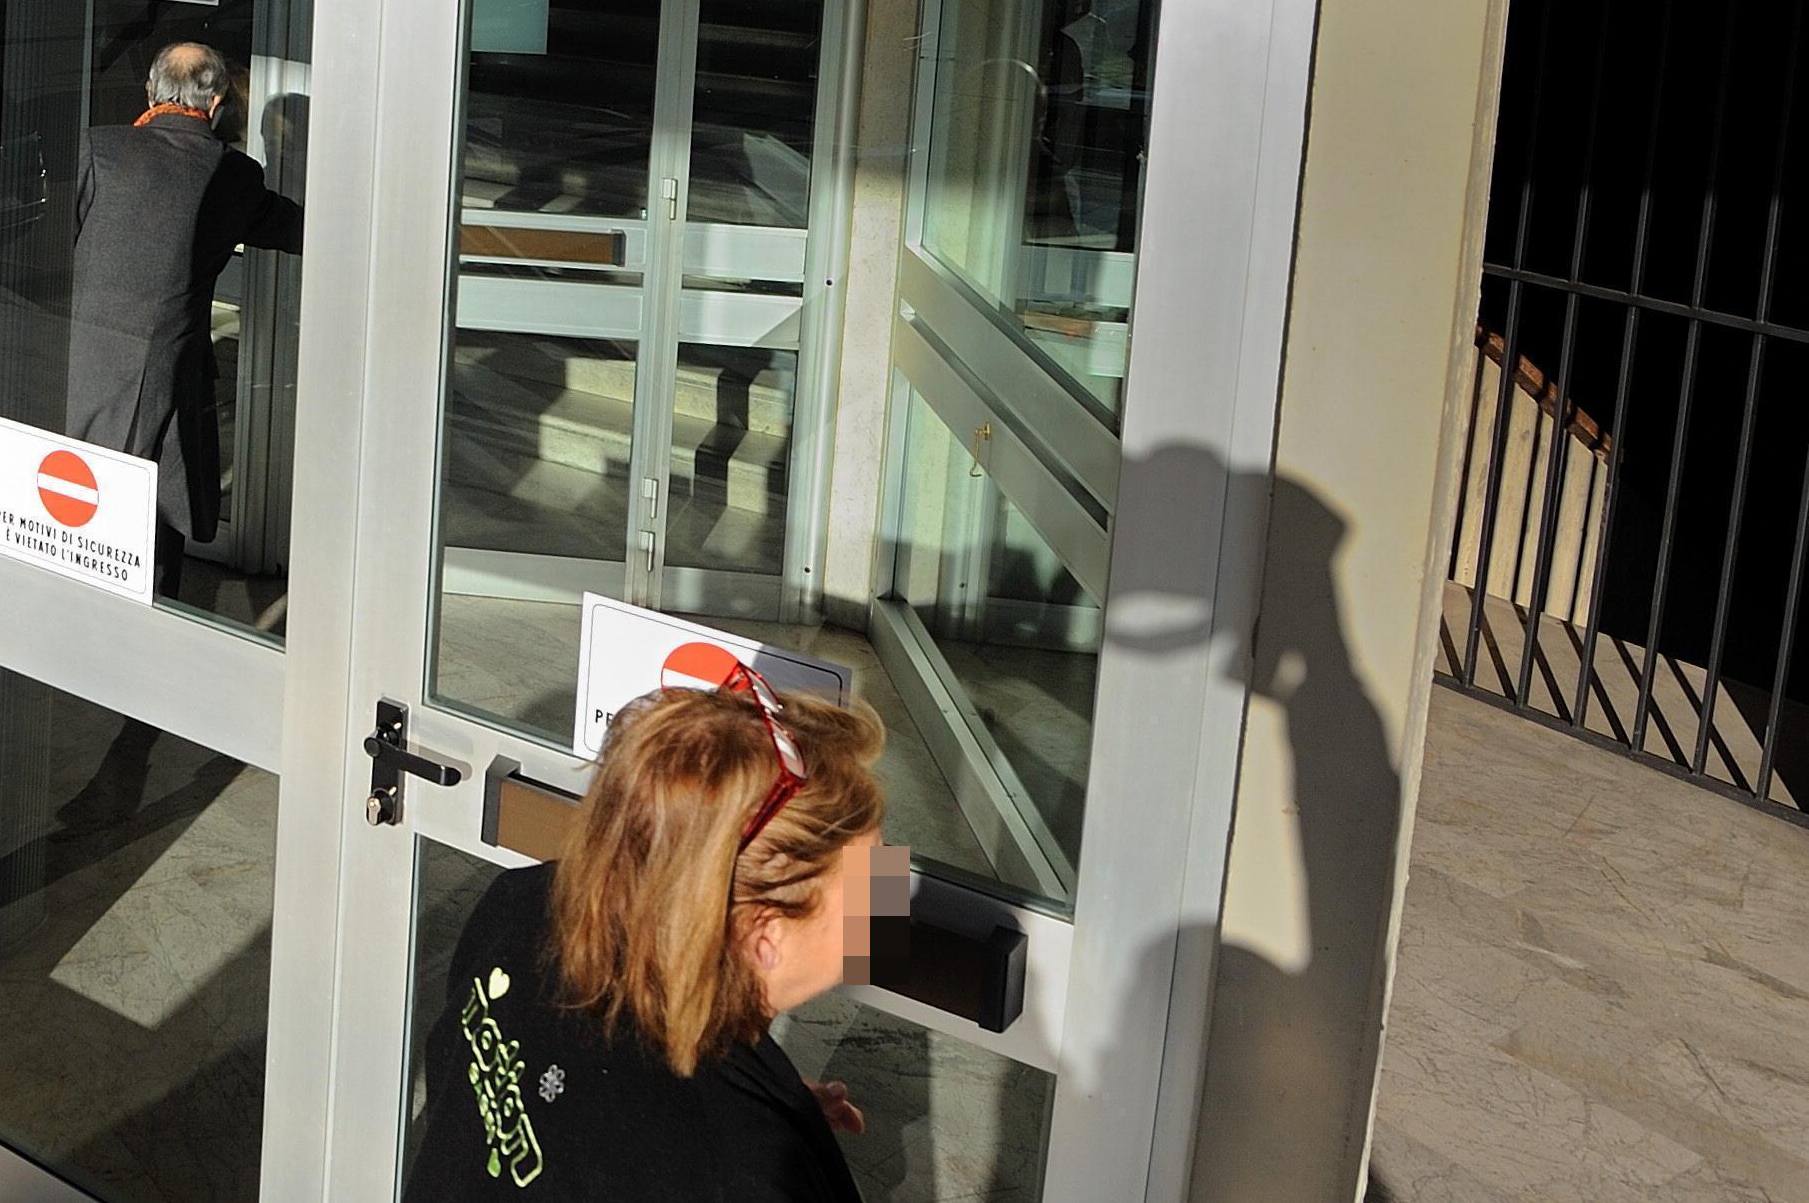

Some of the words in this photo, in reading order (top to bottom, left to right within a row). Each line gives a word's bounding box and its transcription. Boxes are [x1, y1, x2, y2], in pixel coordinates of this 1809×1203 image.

[6, 528, 11, 541] È
[15, 532, 57, 556] VIETATO
[61, 548, 128, 582] L'INGRESSO
[19, 517, 57, 540] MOTIVI
[61, 530, 73, 545] DI
[77, 536, 141, 569] SICUREZZA
